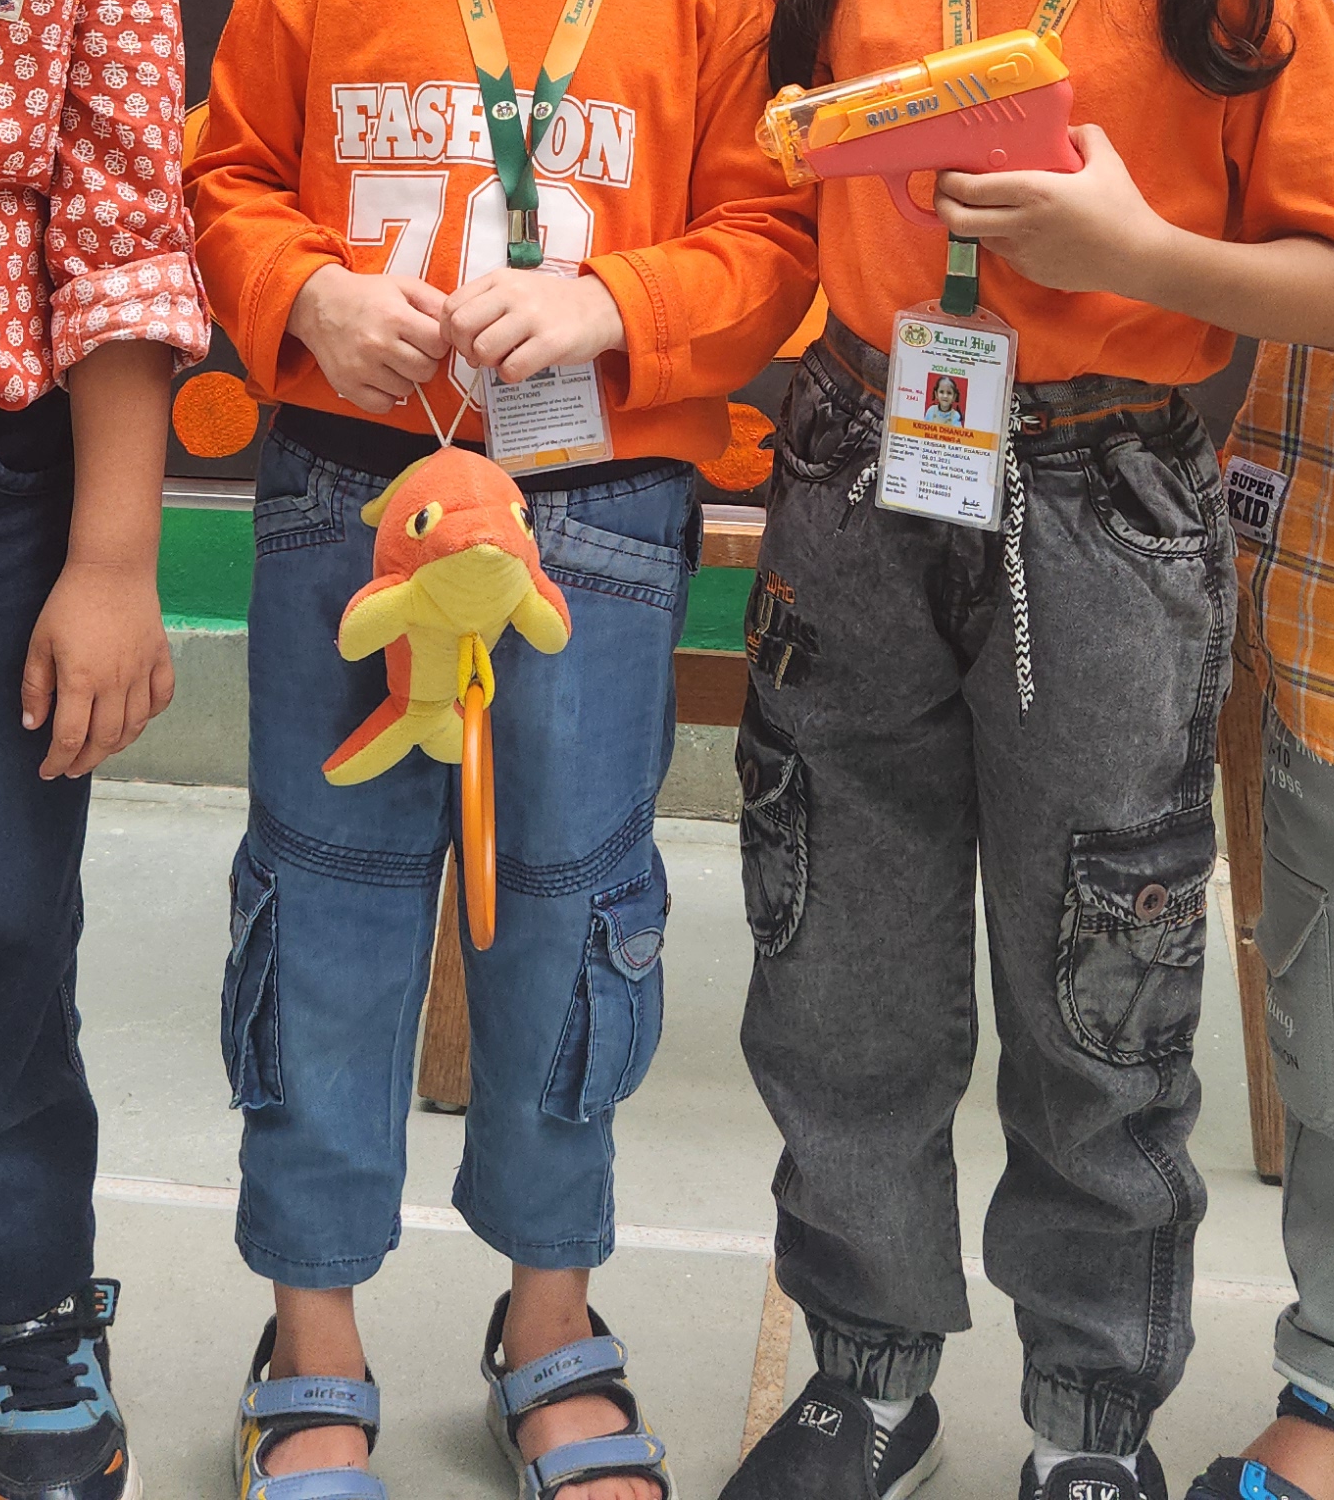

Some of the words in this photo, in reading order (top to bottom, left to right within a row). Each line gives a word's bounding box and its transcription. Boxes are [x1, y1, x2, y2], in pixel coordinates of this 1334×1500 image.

[948, 10, 964, 48] aurel
[865, 95, 940, 128] BIU-BIU
[331, 80, 635, 188] FASHON
[934, 330, 968, 348] Laurel
[970, 336, 996, 354] High
[496, 391, 541, 403] INSTRUCTIONS
[912, 421, 938, 433] KRISHA
[939, 425, 974, 439] DHANUKA
[1229, 470, 1275, 500] SUPER
[1227, 487, 1270, 529] KID
[1269, 764, 1303, 799] 1996
[533, 1353, 583, 1384] airfax
[303, 1384, 357, 1402] airfax
